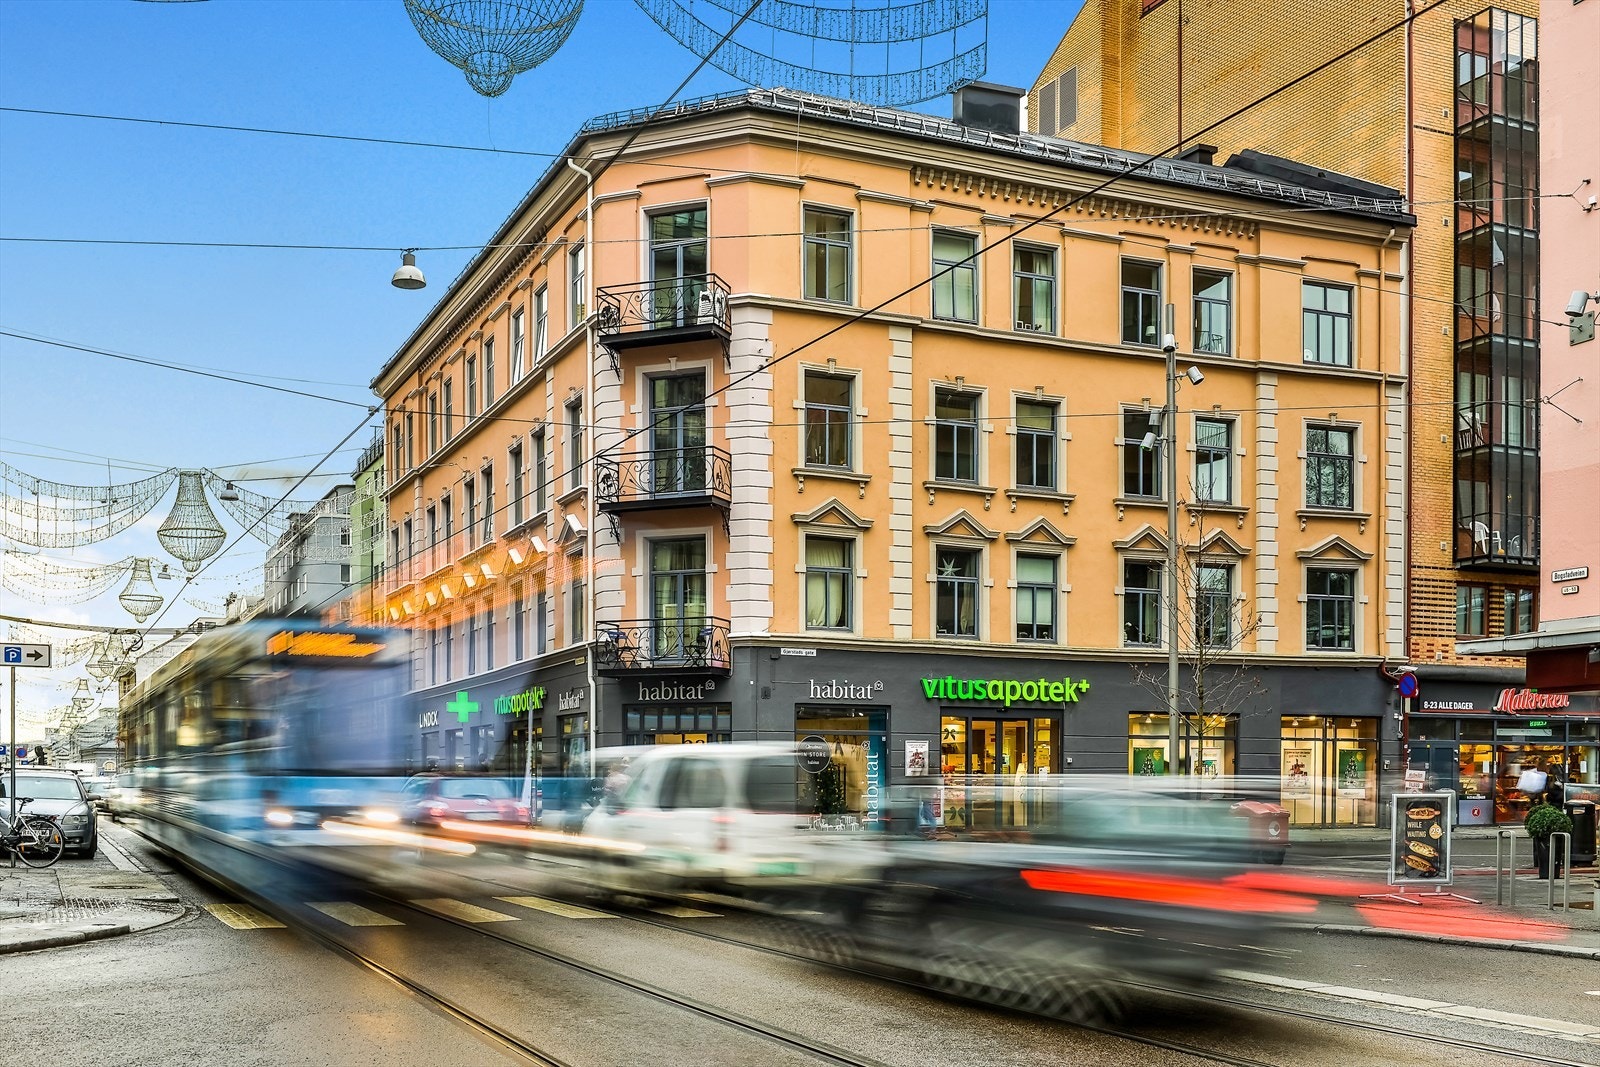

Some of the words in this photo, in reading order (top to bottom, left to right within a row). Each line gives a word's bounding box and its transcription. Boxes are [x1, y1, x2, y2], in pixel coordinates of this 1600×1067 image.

[638, 680, 705, 701] habitat
[809, 679, 874, 700] habitat
[559, 691, 581, 711] habitat
[1423, 701, 1438, 709] 8-23
[1438, 701, 1453, 709] ALLE
[1453, 702, 1474, 710] DAGER
[1492, 687, 1570, 715] Matkroken
[861, 752, 879, 823] habitat
[1407, 821, 1422, 829] WHILE
[1407, 830, 1427, 838] WAITING
